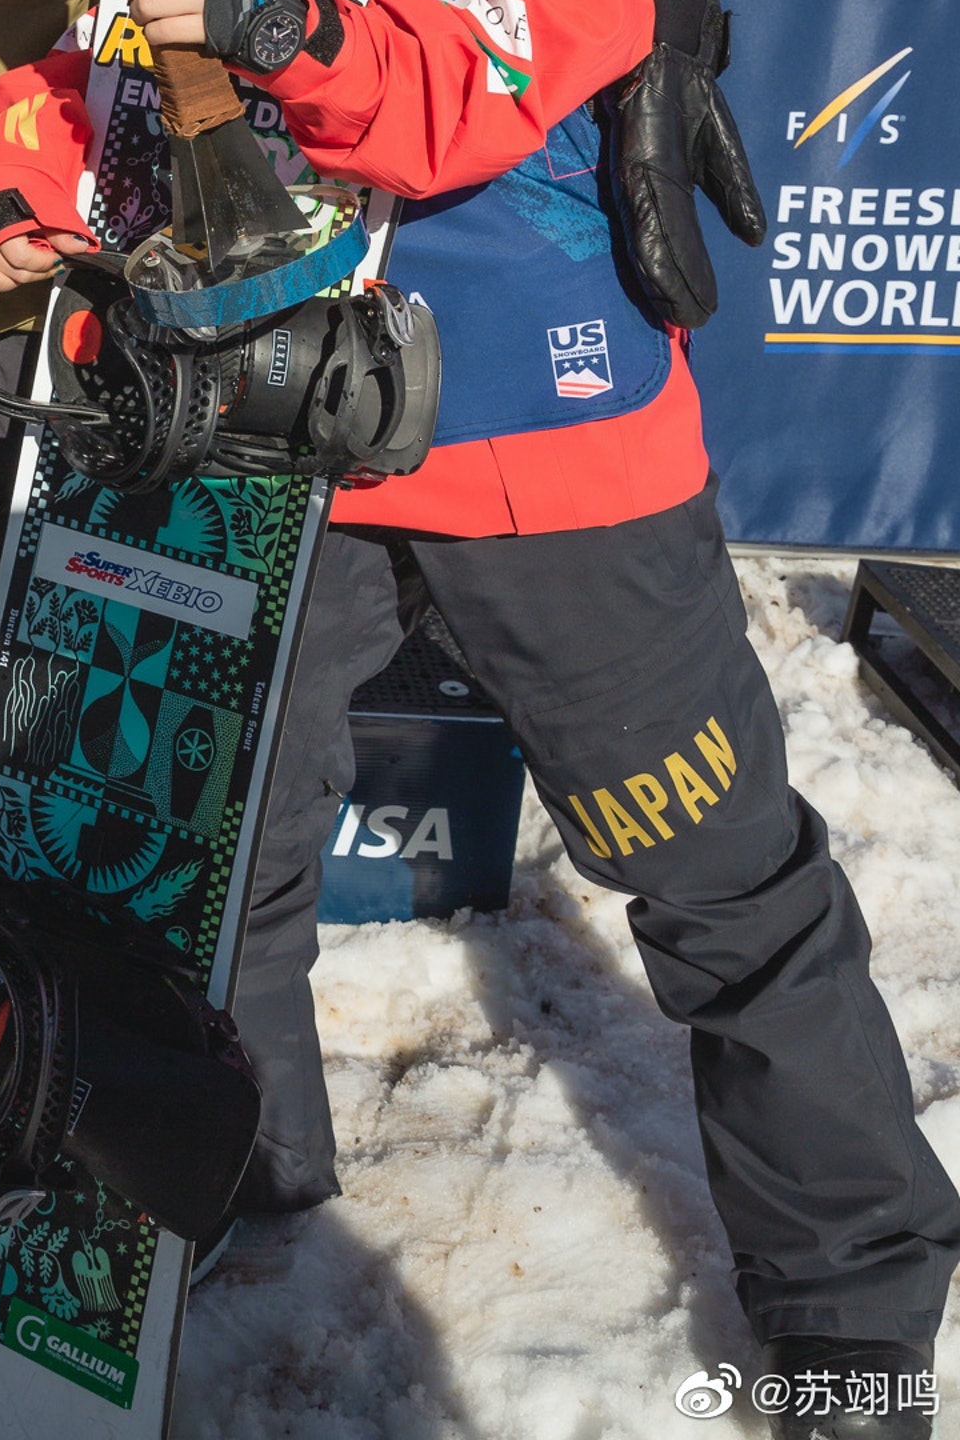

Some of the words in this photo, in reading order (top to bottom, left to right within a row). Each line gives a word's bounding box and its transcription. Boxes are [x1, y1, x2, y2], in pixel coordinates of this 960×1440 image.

[550, 323, 605, 352] US
[553, 345, 606, 360] SNOWBOARD
[65, 557, 126, 586] SPORTS
[83, 551, 133, 578] SUPER
[126, 567, 223, 613] XEBIO
[5, 608, 19, 646] Burton
[0, 650, 11, 668] 141
[250, 680, 266, 715] Talent
[243, 720, 258, 752] Scout
[568, 715, 738, 859] JAPAN
[332, 804, 453, 859] ISA
[46, 1335, 126, 1385] GALLIUM
